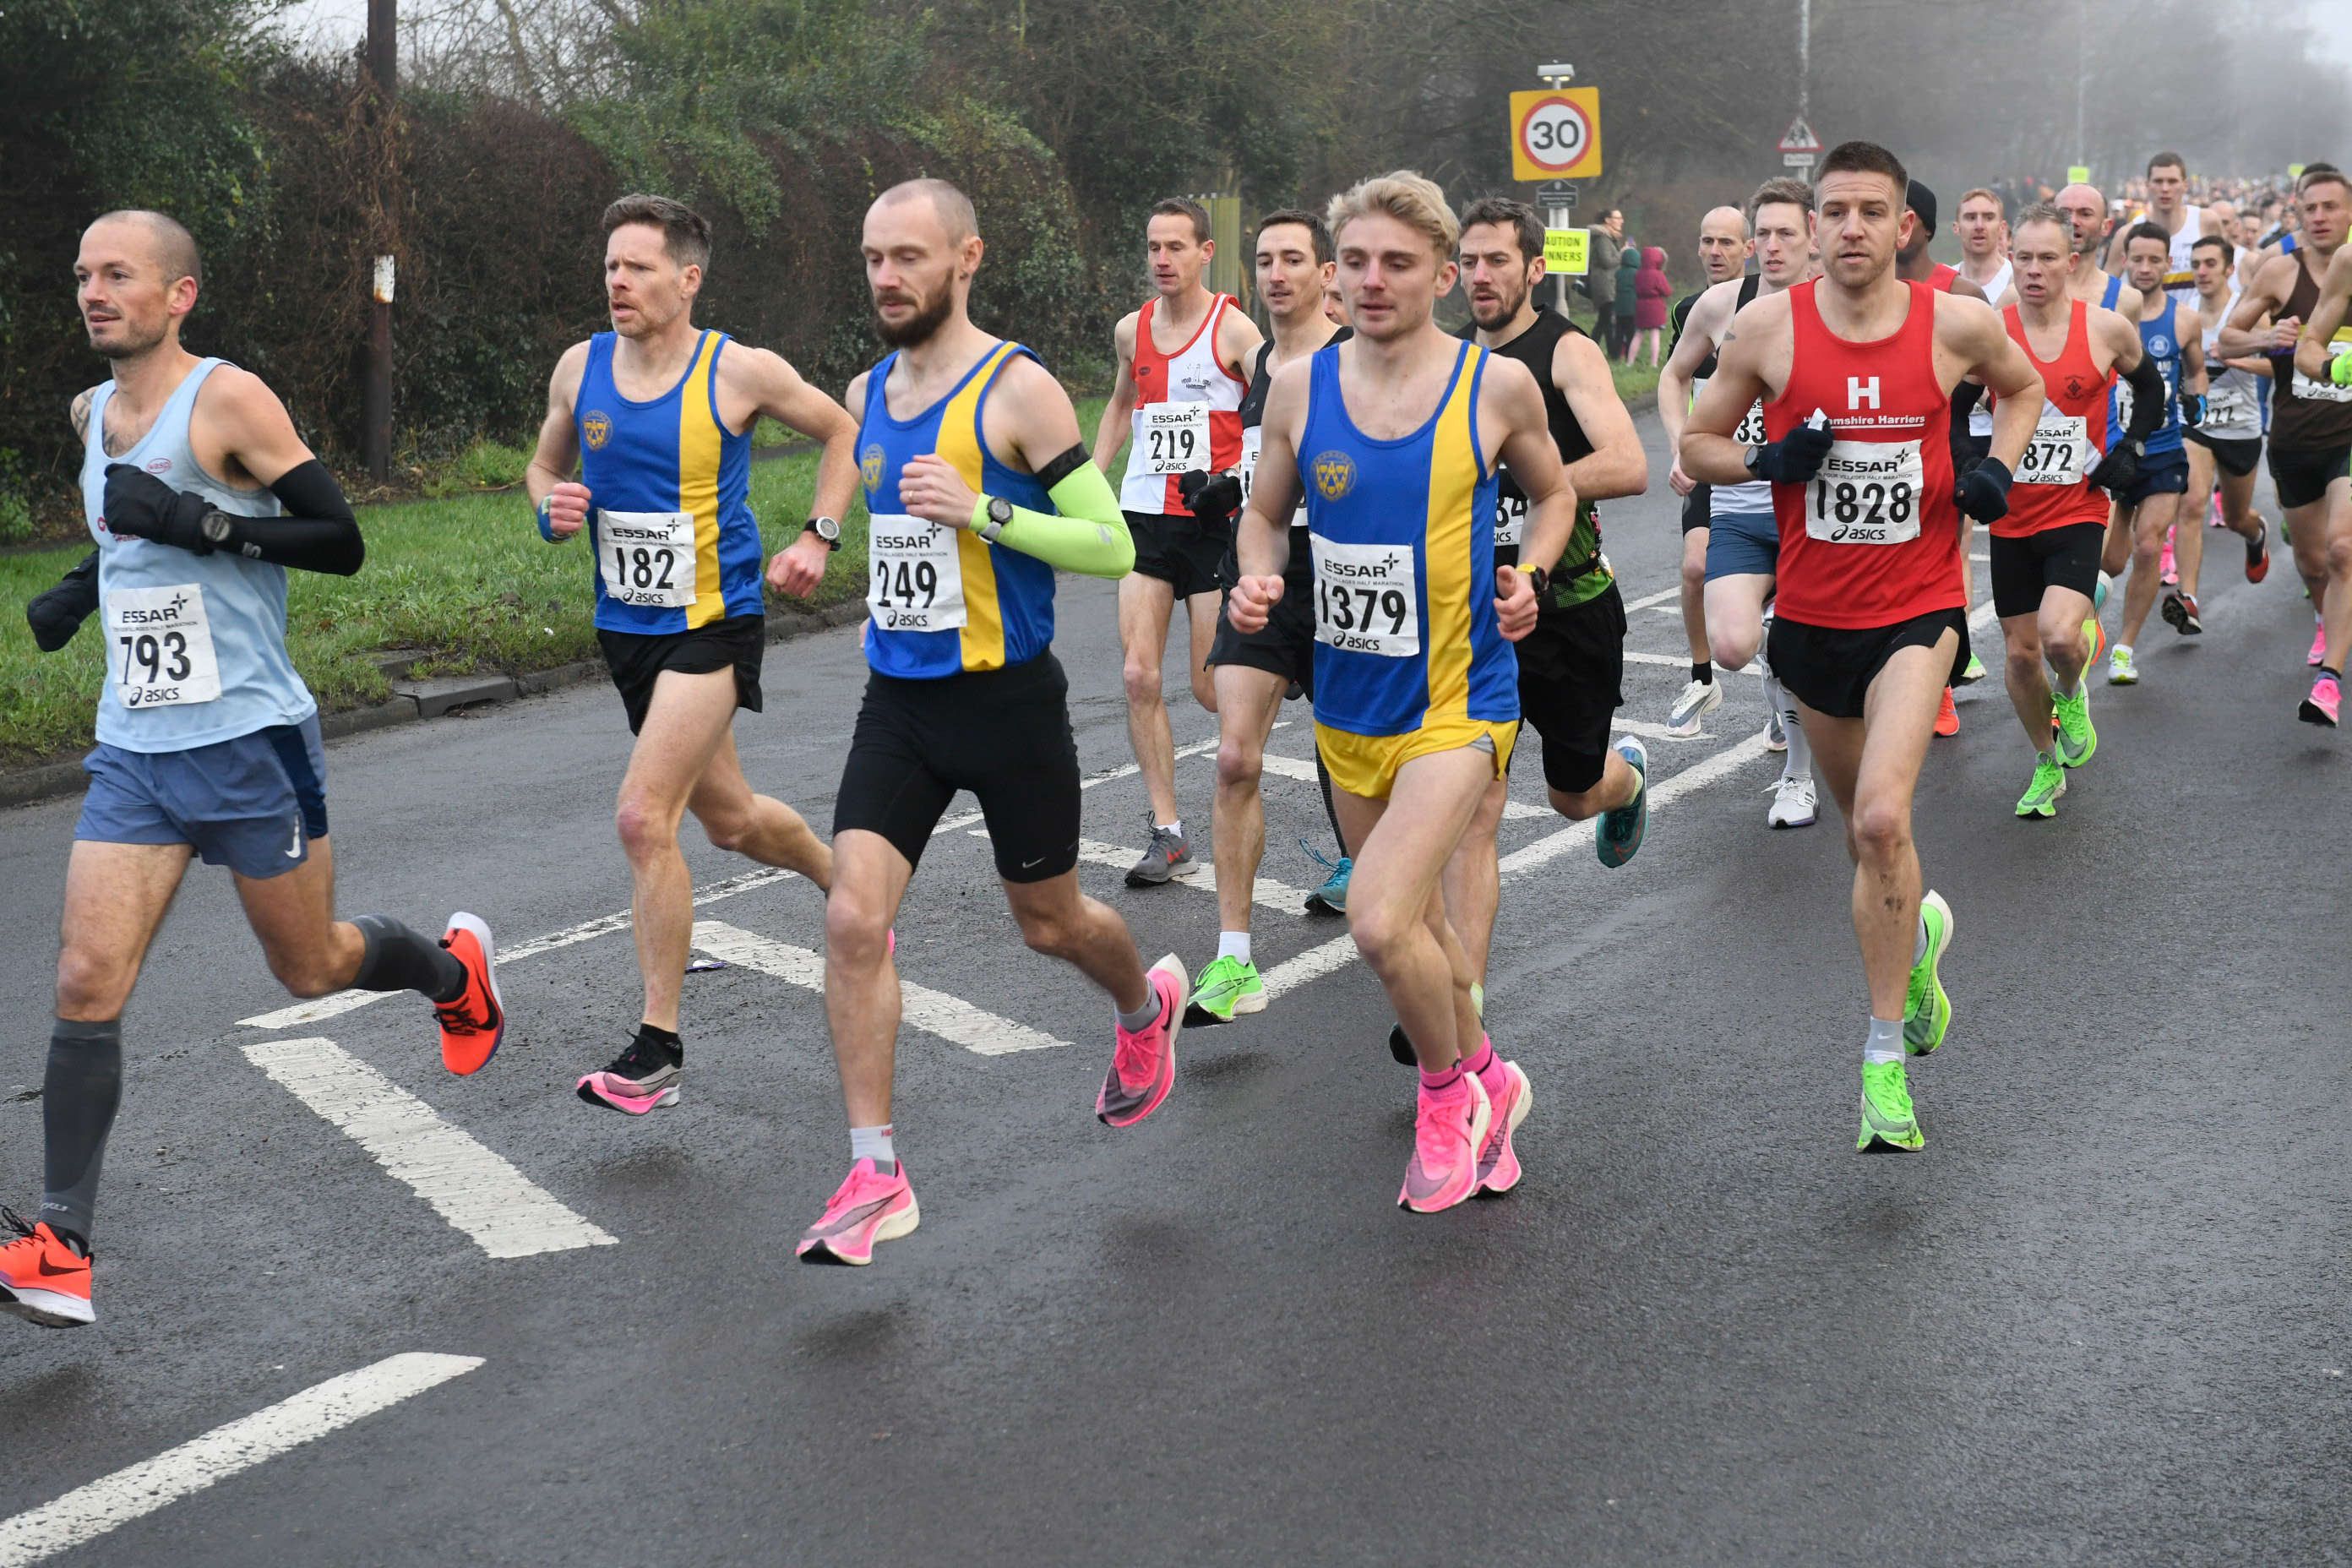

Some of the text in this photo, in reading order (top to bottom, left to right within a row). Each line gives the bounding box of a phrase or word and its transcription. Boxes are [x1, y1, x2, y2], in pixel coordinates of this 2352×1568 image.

[1532, 119, 1579, 150] 30
[1545, 237, 1580, 247] AUTION
[1544, 252, 1582, 262] NNERS
[1847, 376, 1881, 410] H
[1152, 414, 1193, 423] ESSAR
[1878, 414, 1925, 424] Harriers
[1737, 416, 1768, 444] 33
[1150, 428, 1195, 460] 219
[1827, 458, 1898, 473] ESSAR
[1817, 479, 1912, 524] 1828
[612, 527, 670, 541] ESSAR
[876, 535, 931, 549] ESSAR
[1494, 531, 1511, 543] ICS
[616, 547, 674, 589] 182
[1324, 558, 1387, 578] ESSAR
[877, 560, 937, 608] 249
[122, 607, 179, 623] ESSAR
[1321, 578, 1406, 635] 1379
[120, 631, 191, 685] 793
